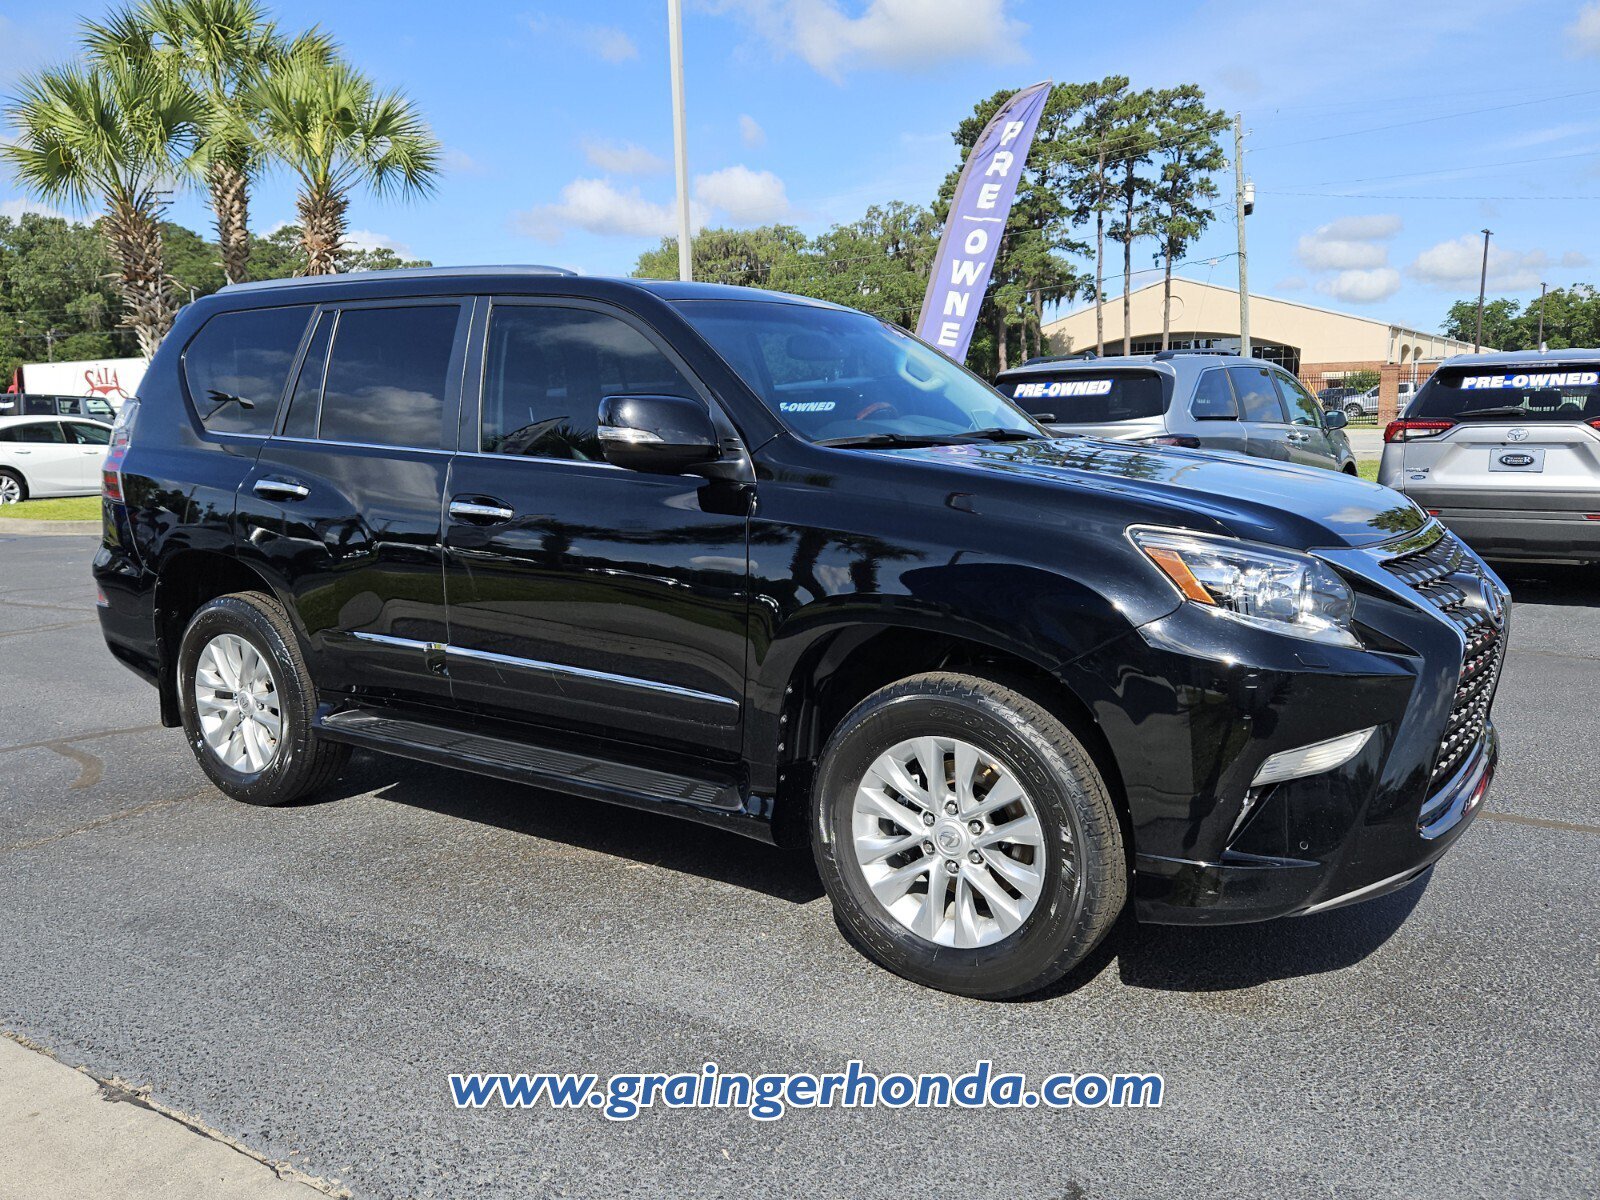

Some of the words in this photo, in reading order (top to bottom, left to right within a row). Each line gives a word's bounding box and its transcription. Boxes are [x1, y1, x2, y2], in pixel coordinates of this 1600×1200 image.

[84, 367, 121, 392] SAIA
[1461, 372, 1598, 390] PRE-OWNED
[1013, 380, 1112, 398] PRE-OWNED
